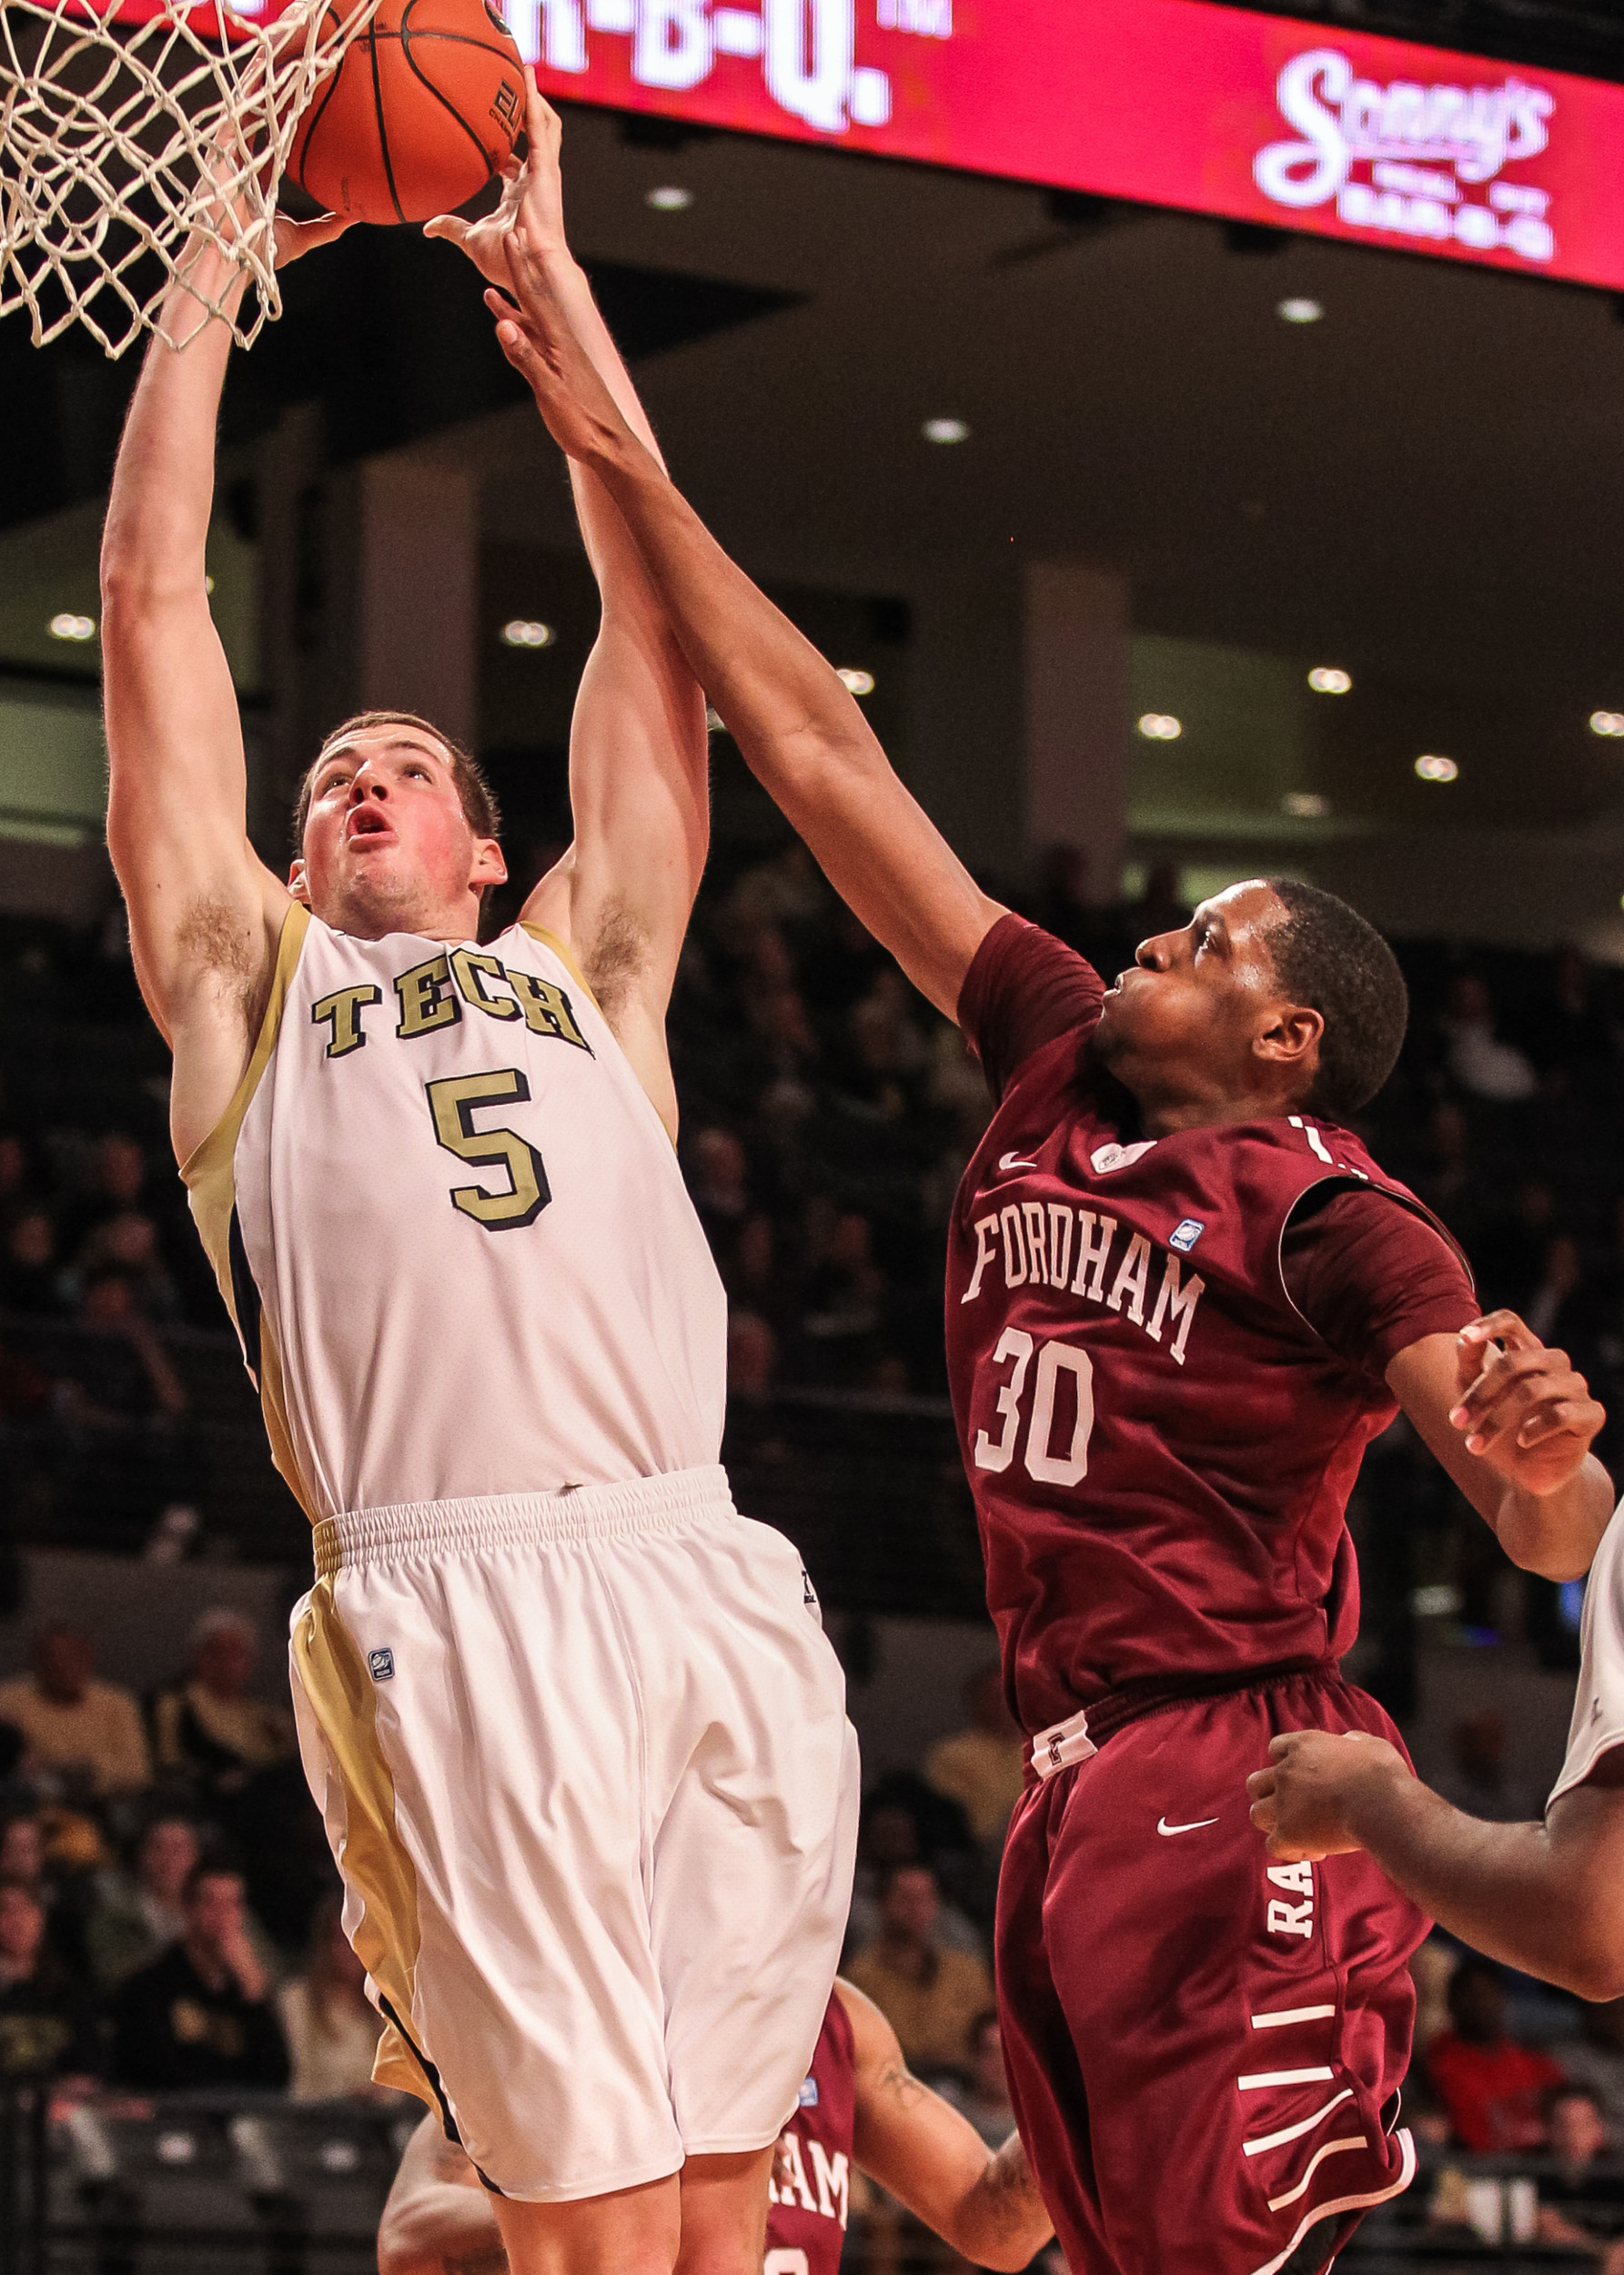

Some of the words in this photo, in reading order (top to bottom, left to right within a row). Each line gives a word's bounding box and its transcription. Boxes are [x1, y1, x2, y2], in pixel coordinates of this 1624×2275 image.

[311, 947, 597, 1060] TECH
[425, 1067, 552, 1232] 5
[962, 1201, 1205, 1365] FORDHAM
[974, 1326, 1094, 1487] 30
[768, 2131, 849, 2231] AM
